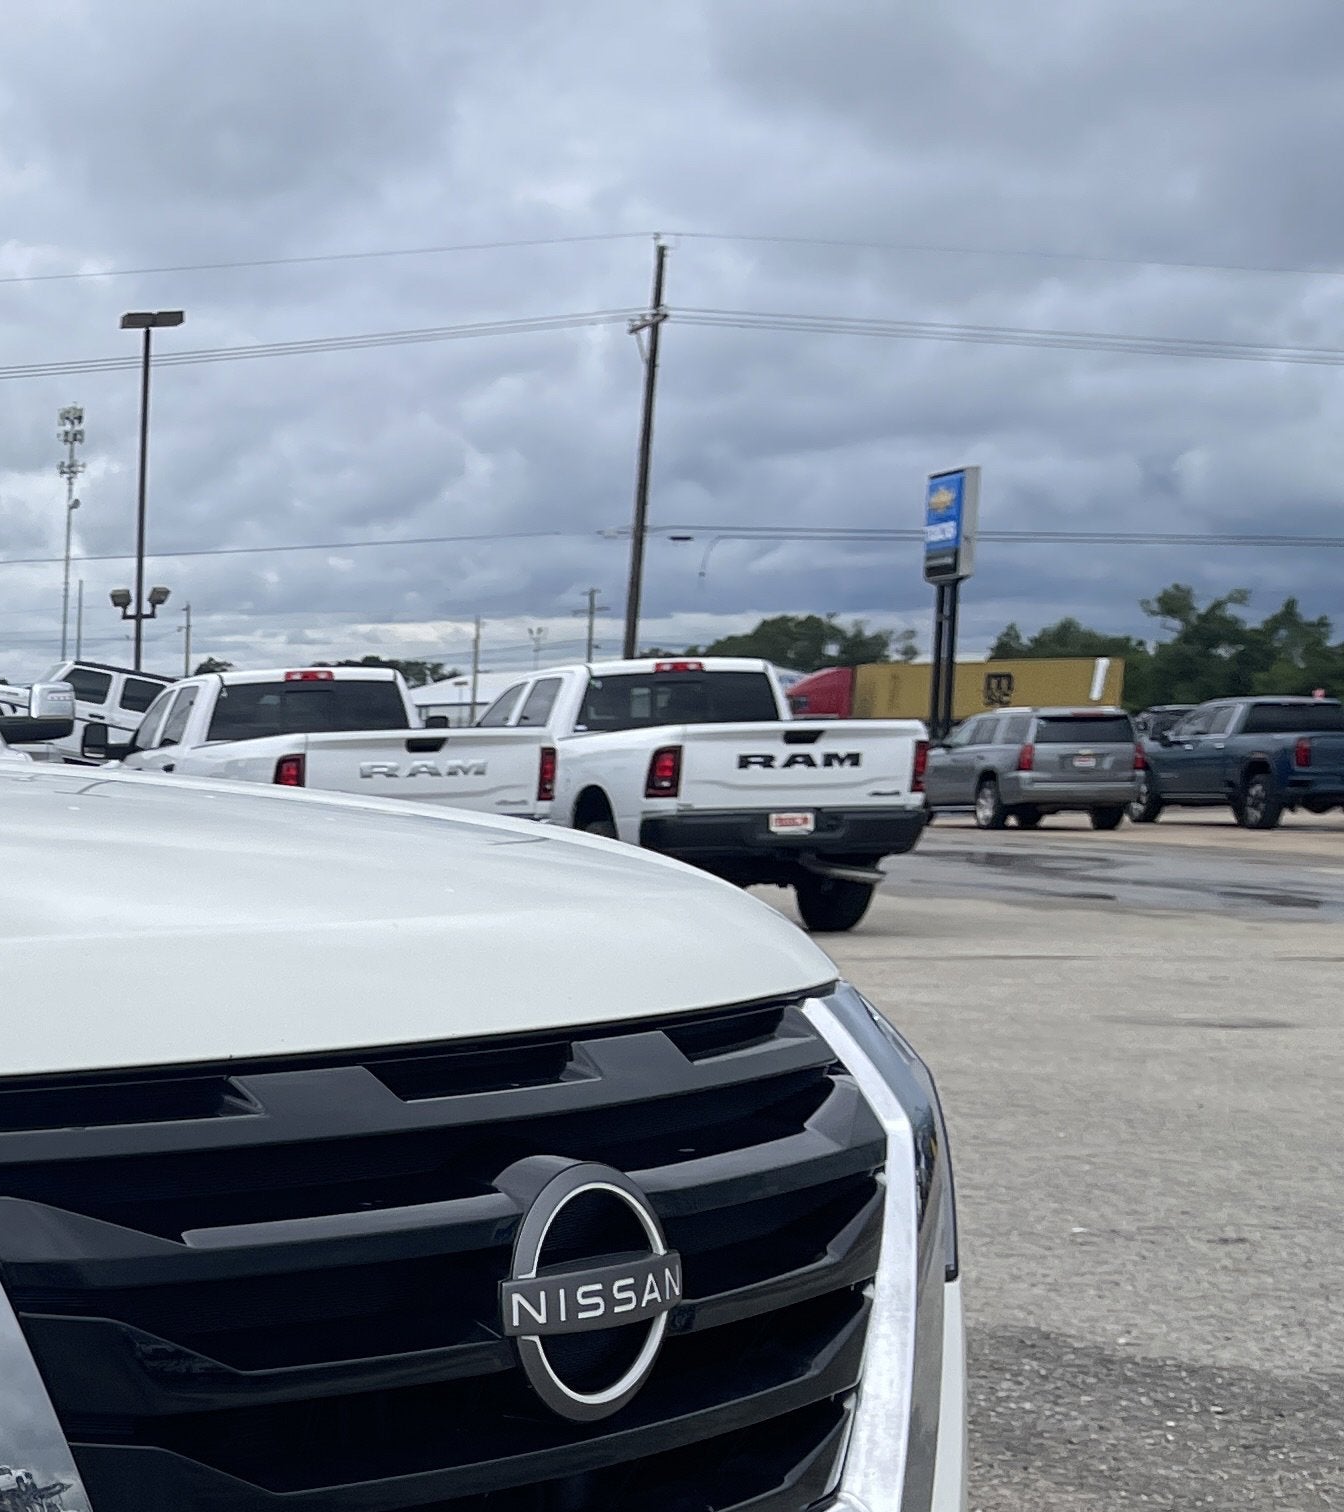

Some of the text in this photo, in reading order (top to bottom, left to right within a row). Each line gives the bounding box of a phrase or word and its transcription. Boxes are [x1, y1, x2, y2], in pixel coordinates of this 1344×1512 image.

[360, 760, 488, 778] RAM
[736, 752, 861, 769] RAM
[511, 1264, 681, 1327] NISSAN
